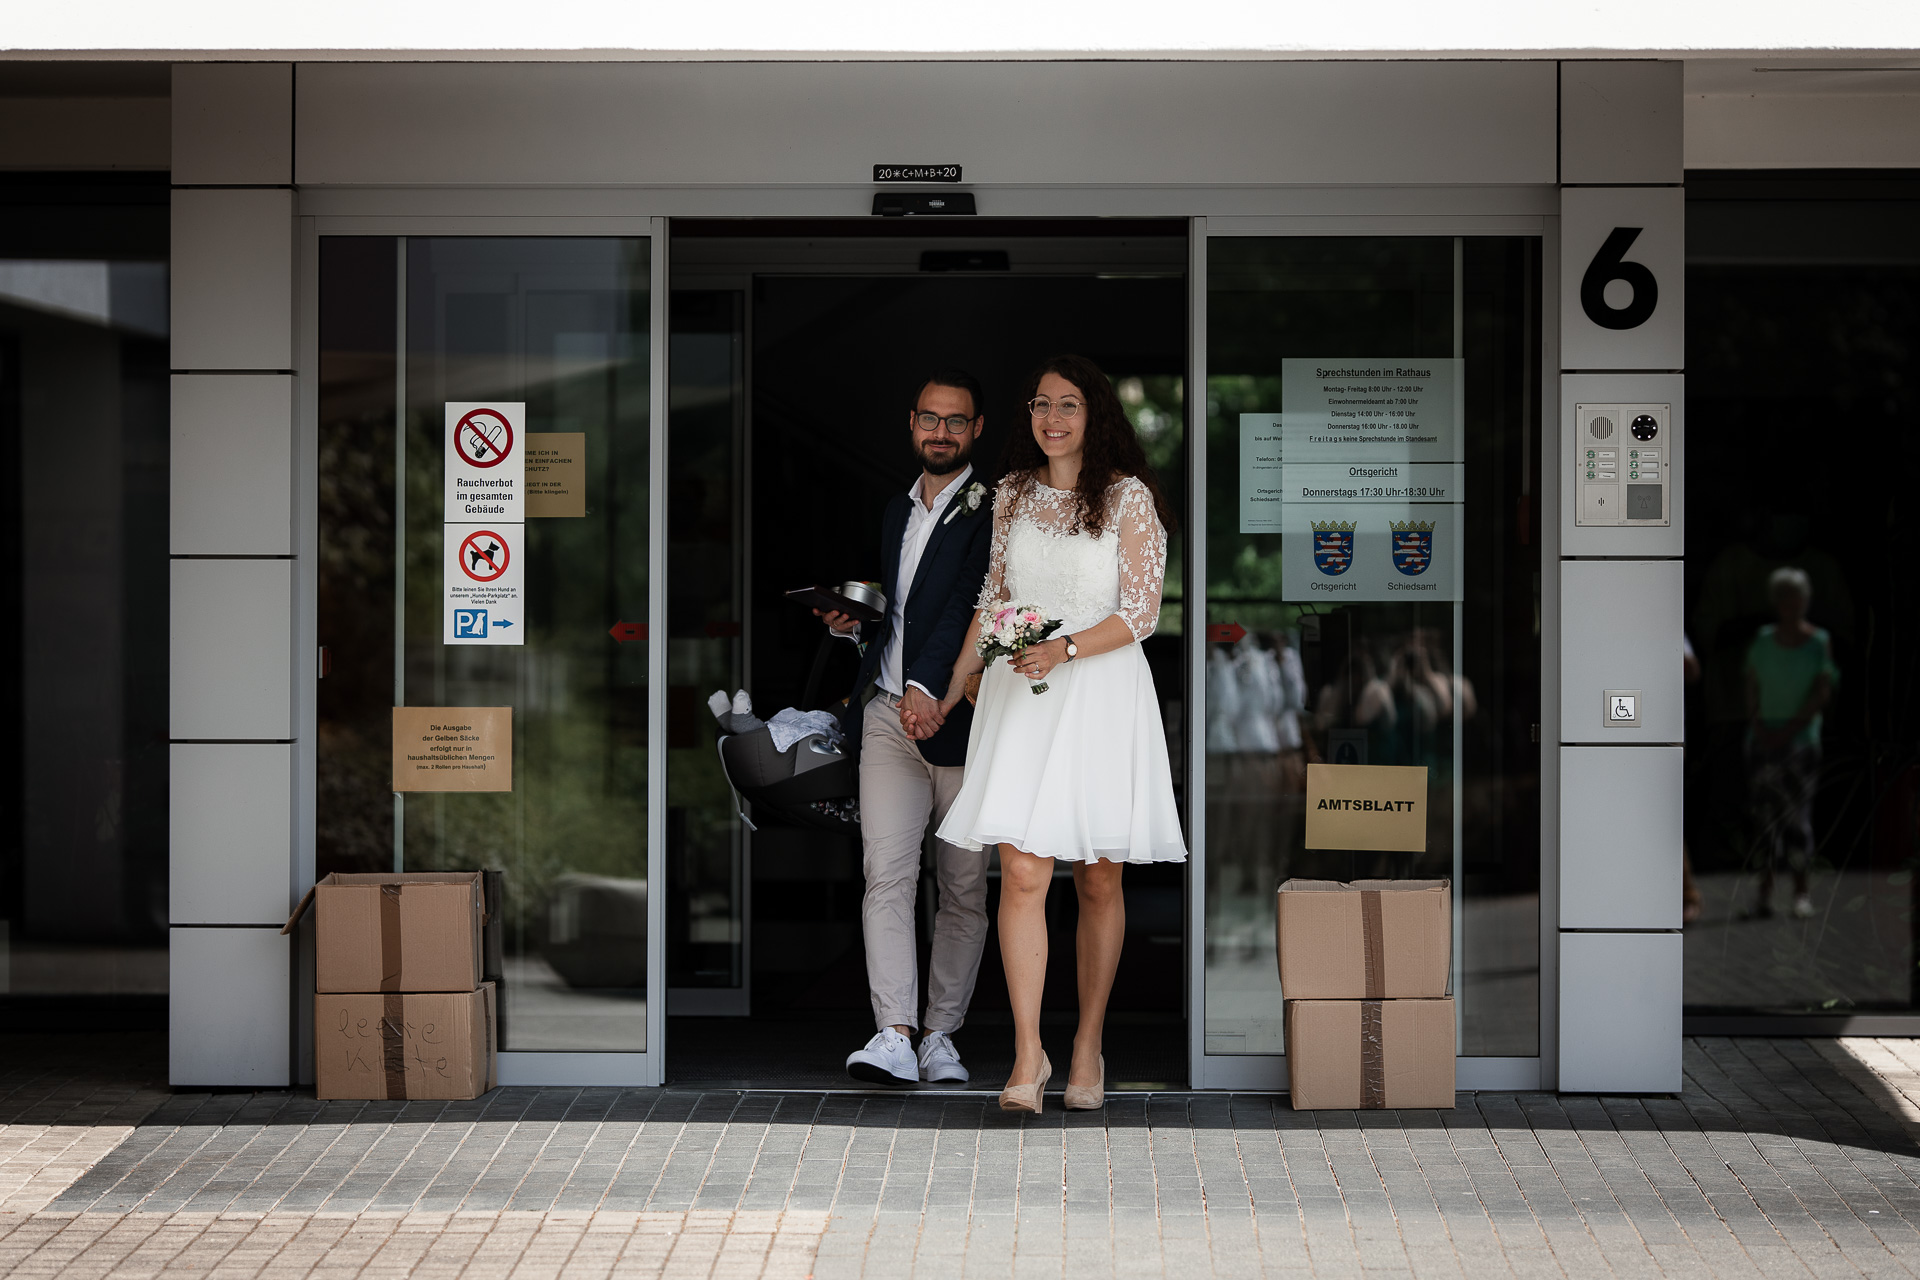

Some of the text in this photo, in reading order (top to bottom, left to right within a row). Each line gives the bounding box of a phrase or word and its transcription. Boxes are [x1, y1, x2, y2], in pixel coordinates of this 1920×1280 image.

[1580, 226, 1658, 330] 6
[1316, 368, 1431, 378] Sprechstunden im Rathaus
[1349, 467, 1398, 477] Ortsgericht
[457, 478, 513, 487] Rauchverbot
[456, 491, 513, 502] im gesamten
[1302, 488, 1445, 497] Donnerstags 17:30 Uhr-18:30 Uhr
[465, 505, 505, 514] Gebäude
[1310, 582, 1356, 592] Ortsgericht
[1388, 582, 1437, 590] Schiedsamt
[1317, 799, 1415, 812] AMTSBLATT
